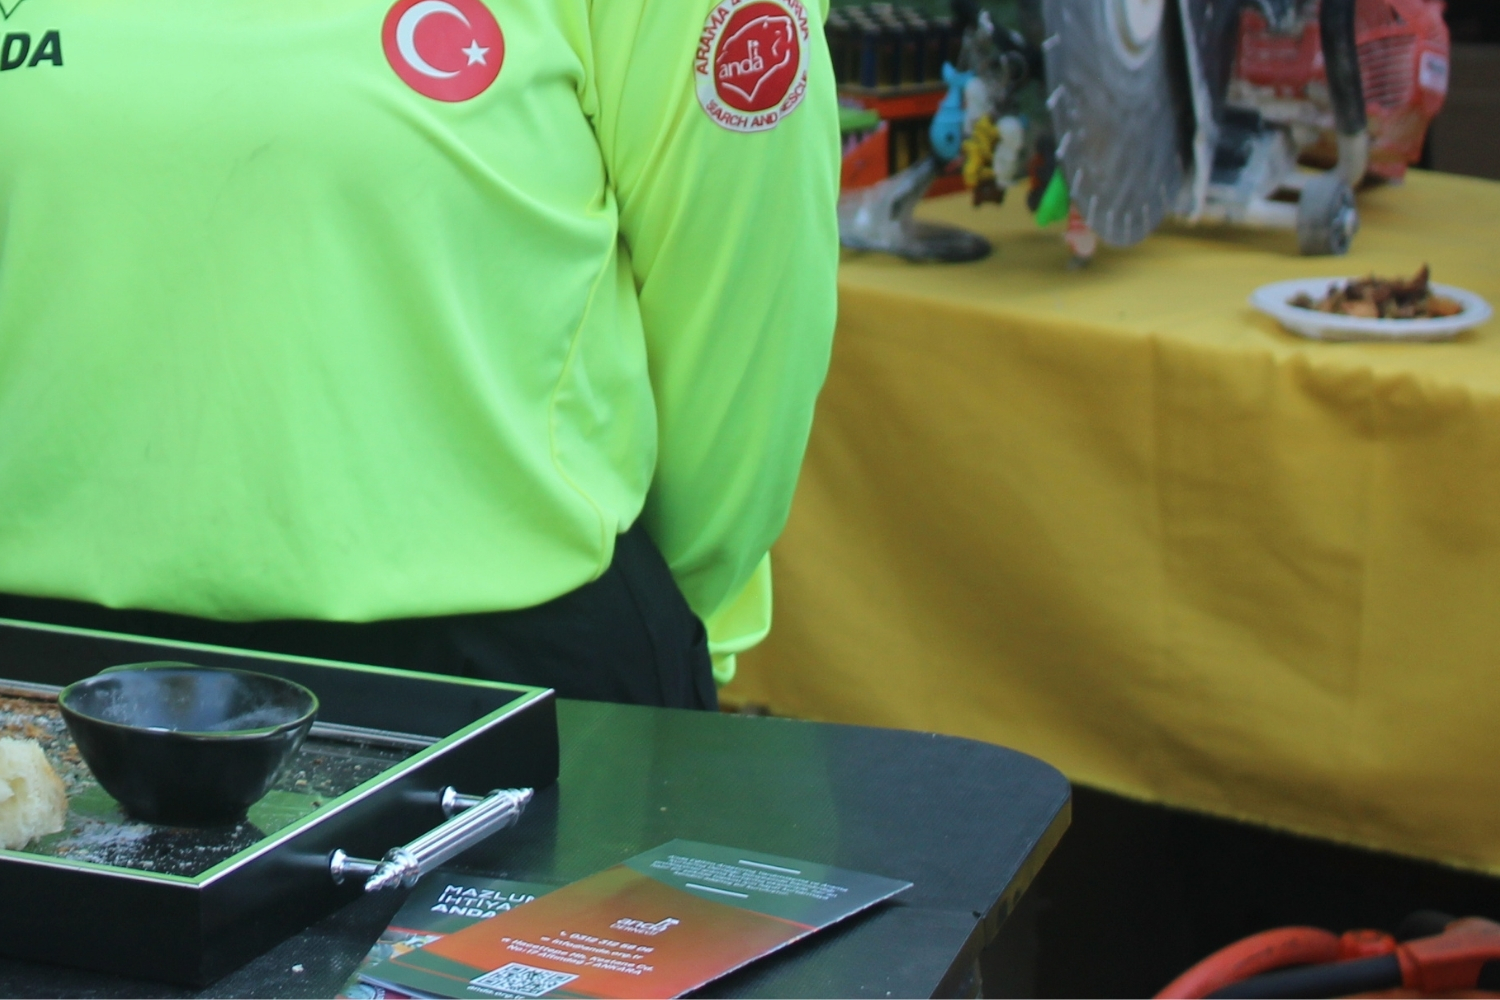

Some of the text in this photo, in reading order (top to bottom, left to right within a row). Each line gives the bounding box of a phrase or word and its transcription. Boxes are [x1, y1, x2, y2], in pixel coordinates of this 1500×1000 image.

[696, 7, 730, 75] ARAMA
[719, 39, 764, 80] anda
[751, 112, 779, 128] AND
[430, 903, 498, 919] ANDA
